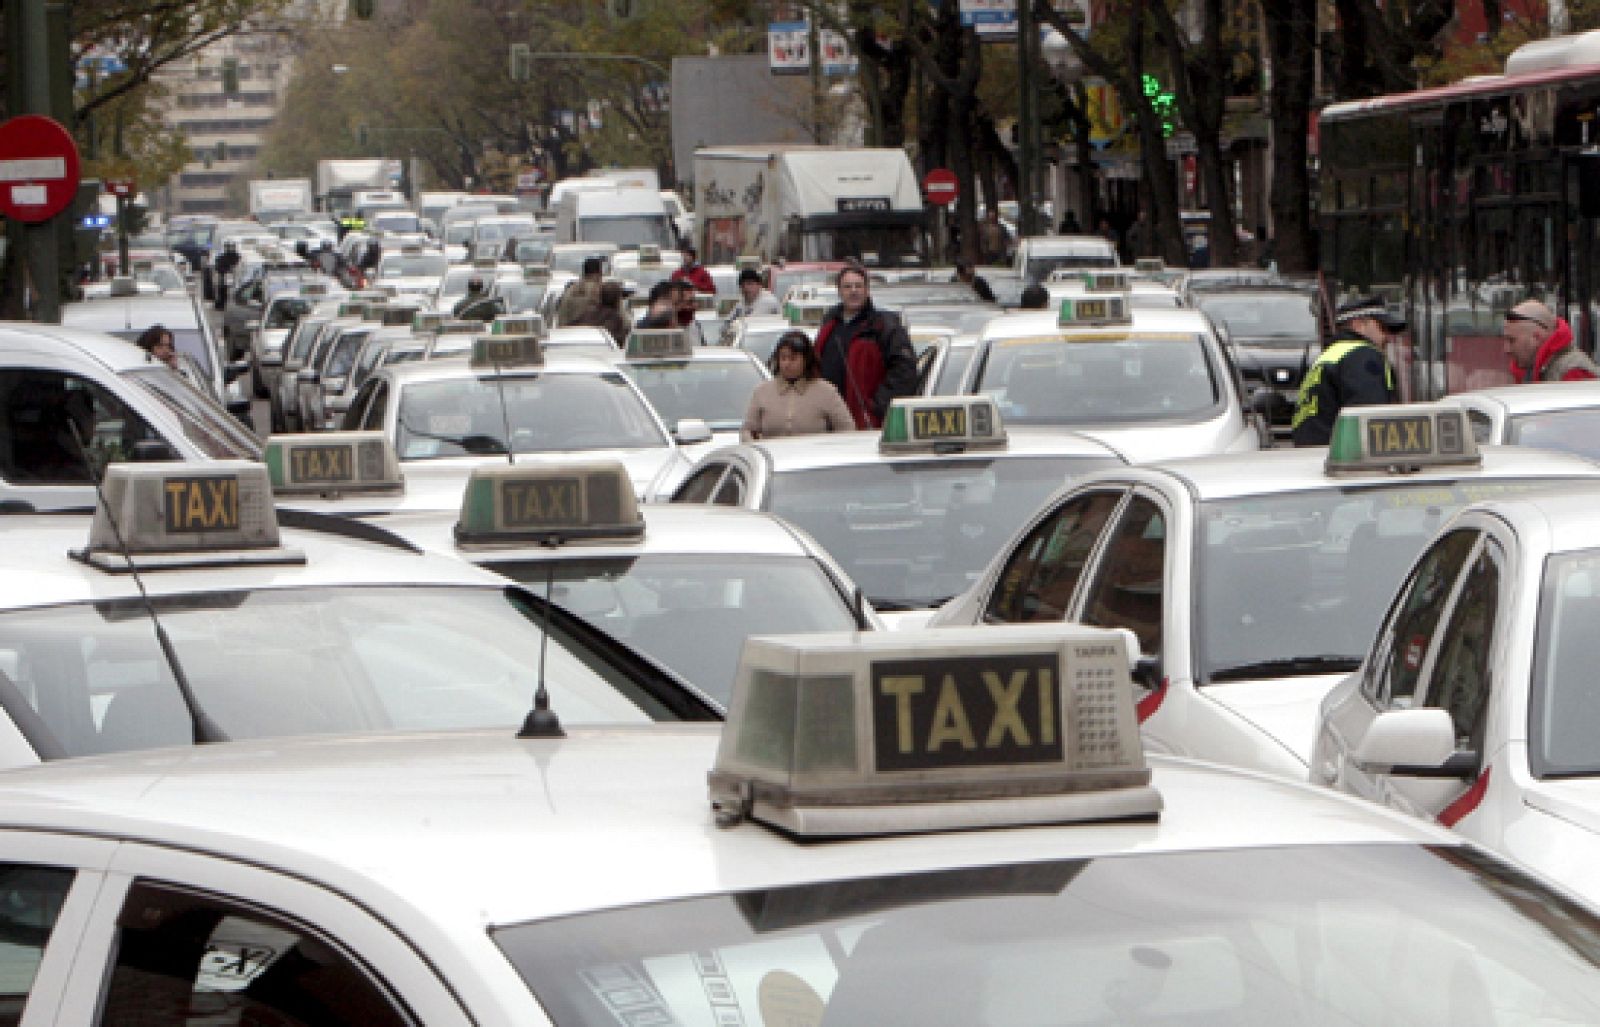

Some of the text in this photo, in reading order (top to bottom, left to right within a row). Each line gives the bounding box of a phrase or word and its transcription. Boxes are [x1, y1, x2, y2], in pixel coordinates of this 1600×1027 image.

[914, 410, 965, 434] TAXI
[1370, 421, 1431, 451] TAXI
[292, 447, 351, 478] TAXI
[166, 480, 238, 528] TAXI
[506, 485, 577, 521] TAXI
[880, 668, 1055, 753] TAXI
